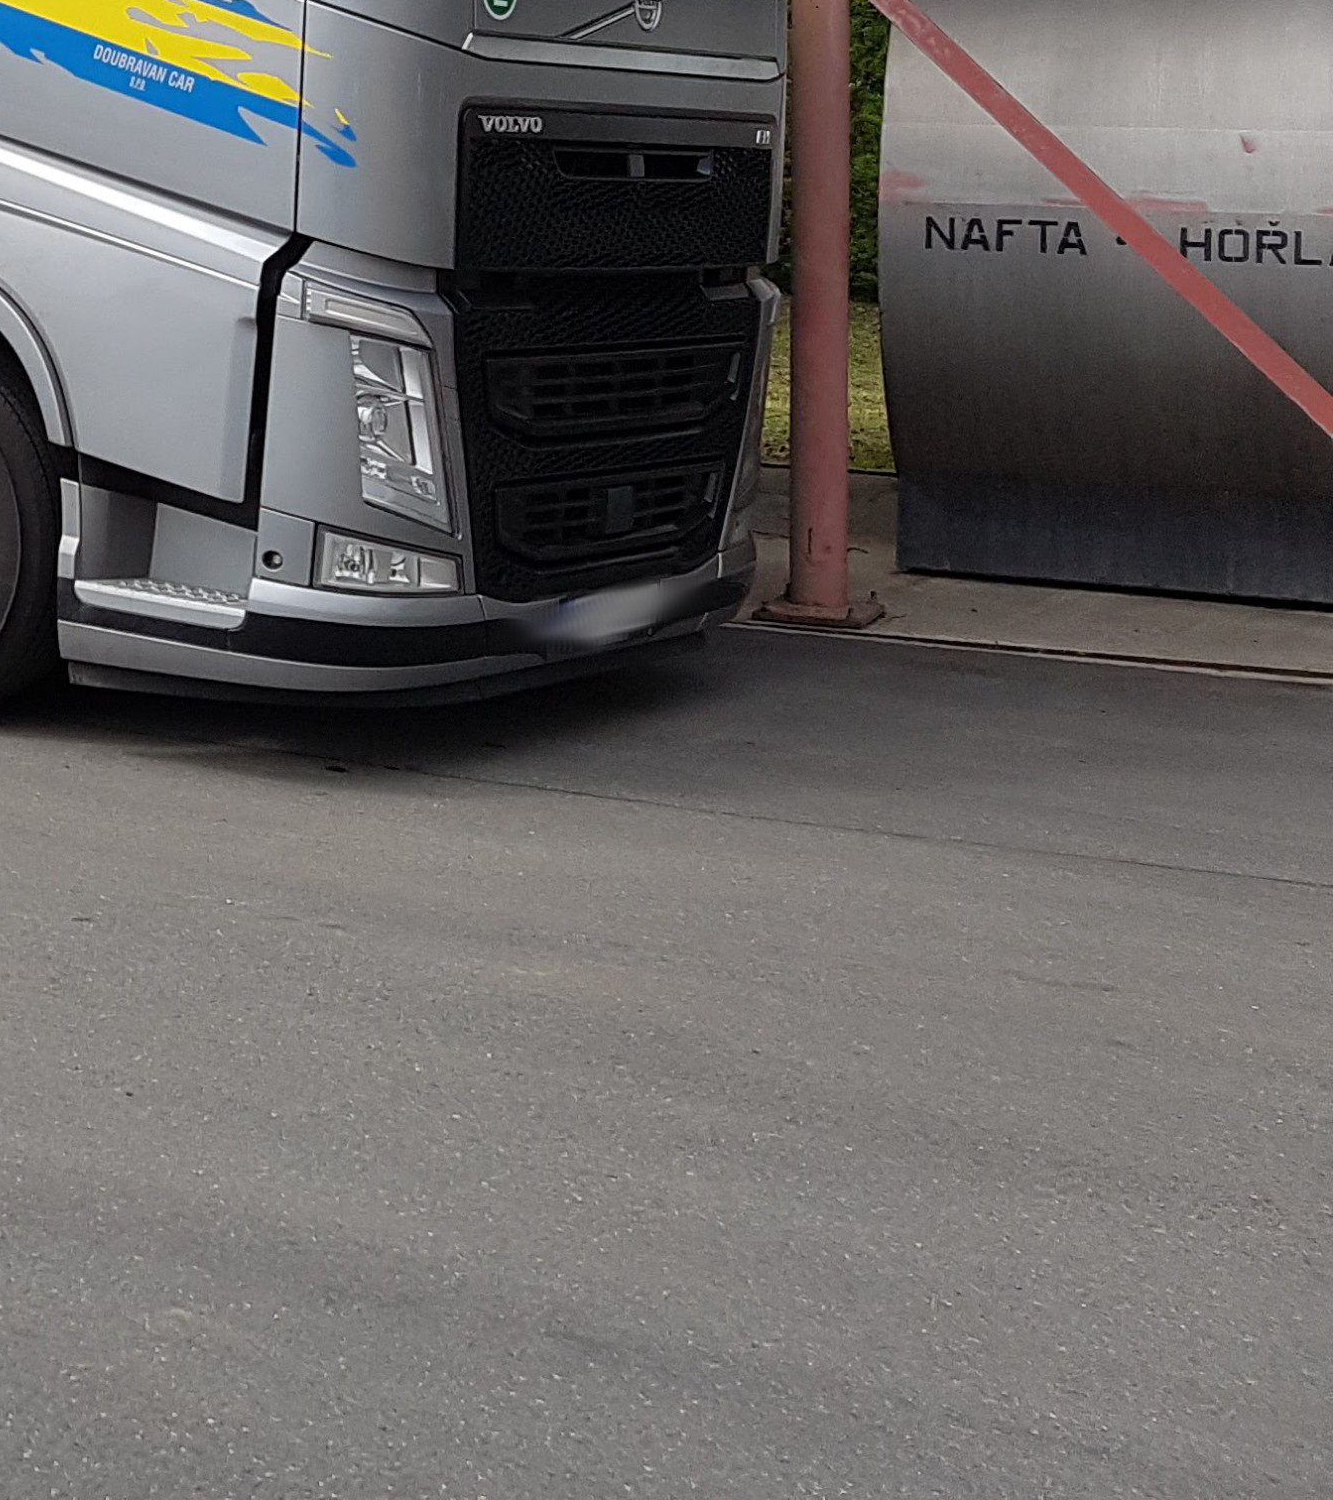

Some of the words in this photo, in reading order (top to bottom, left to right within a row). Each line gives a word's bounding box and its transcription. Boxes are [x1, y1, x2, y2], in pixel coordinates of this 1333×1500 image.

[93, 44, 168, 83] DOUBRAVAN
[168, 71, 195, 93] CAR
[477, 114, 543, 134] VOLVO
[924, 216, 1088, 256] NAFTA
[1178, 219, 1333, 266] HOŘL
